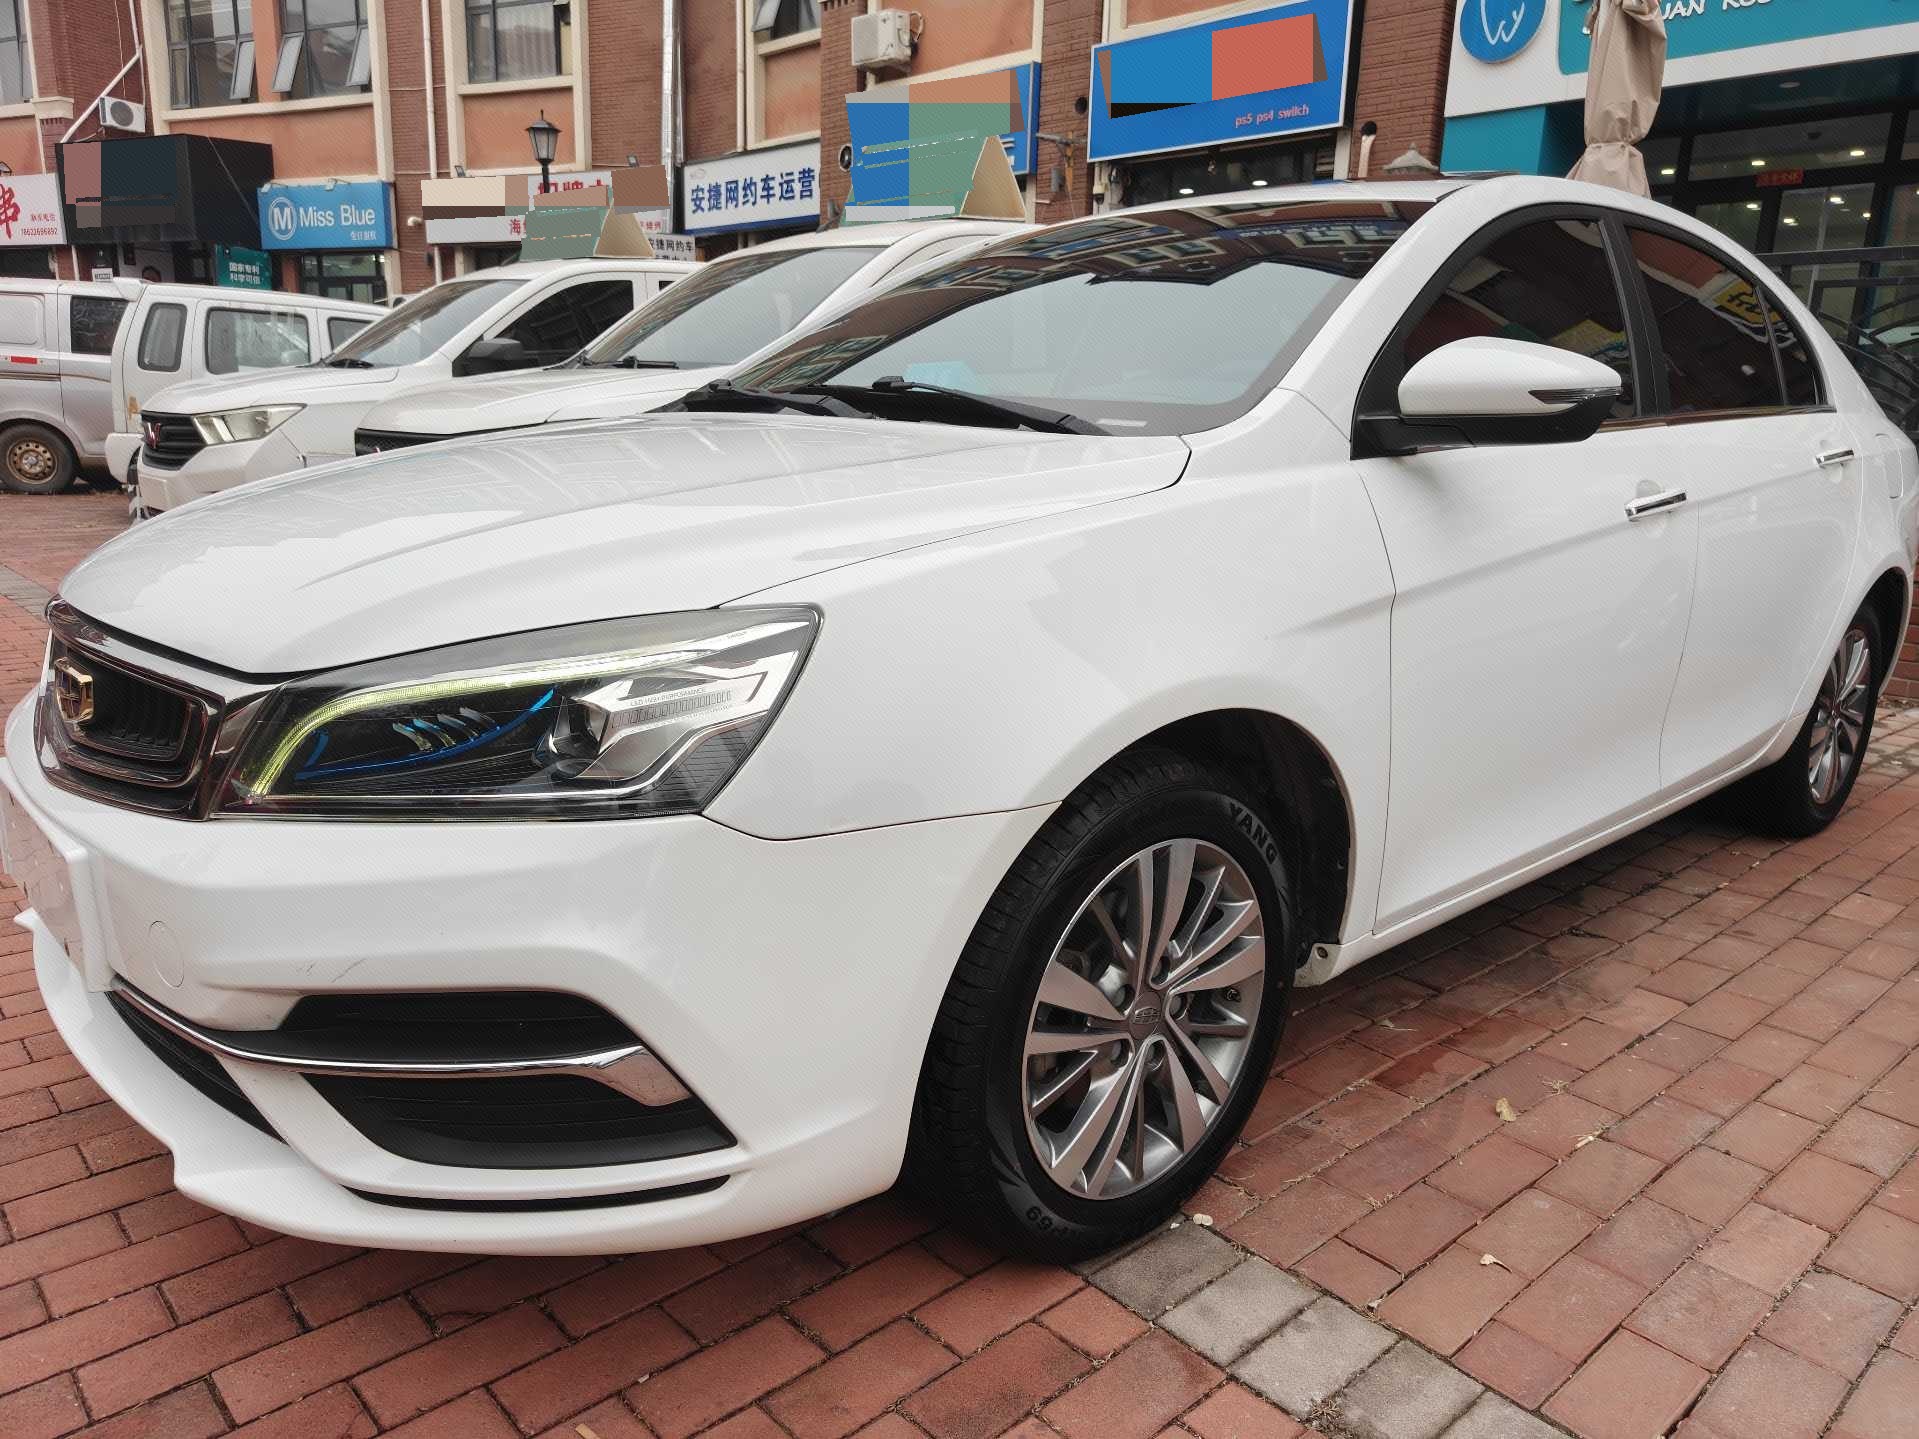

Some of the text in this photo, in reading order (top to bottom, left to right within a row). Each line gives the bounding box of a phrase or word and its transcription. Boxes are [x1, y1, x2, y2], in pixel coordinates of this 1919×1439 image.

[1235, 103, 1310, 128] ps5 ps4 switch
[691, 167, 816, 215] 安捷网约车运营
[299, 204, 376, 228] Miss Blue
[1229, 801, 1278, 865] YANG
